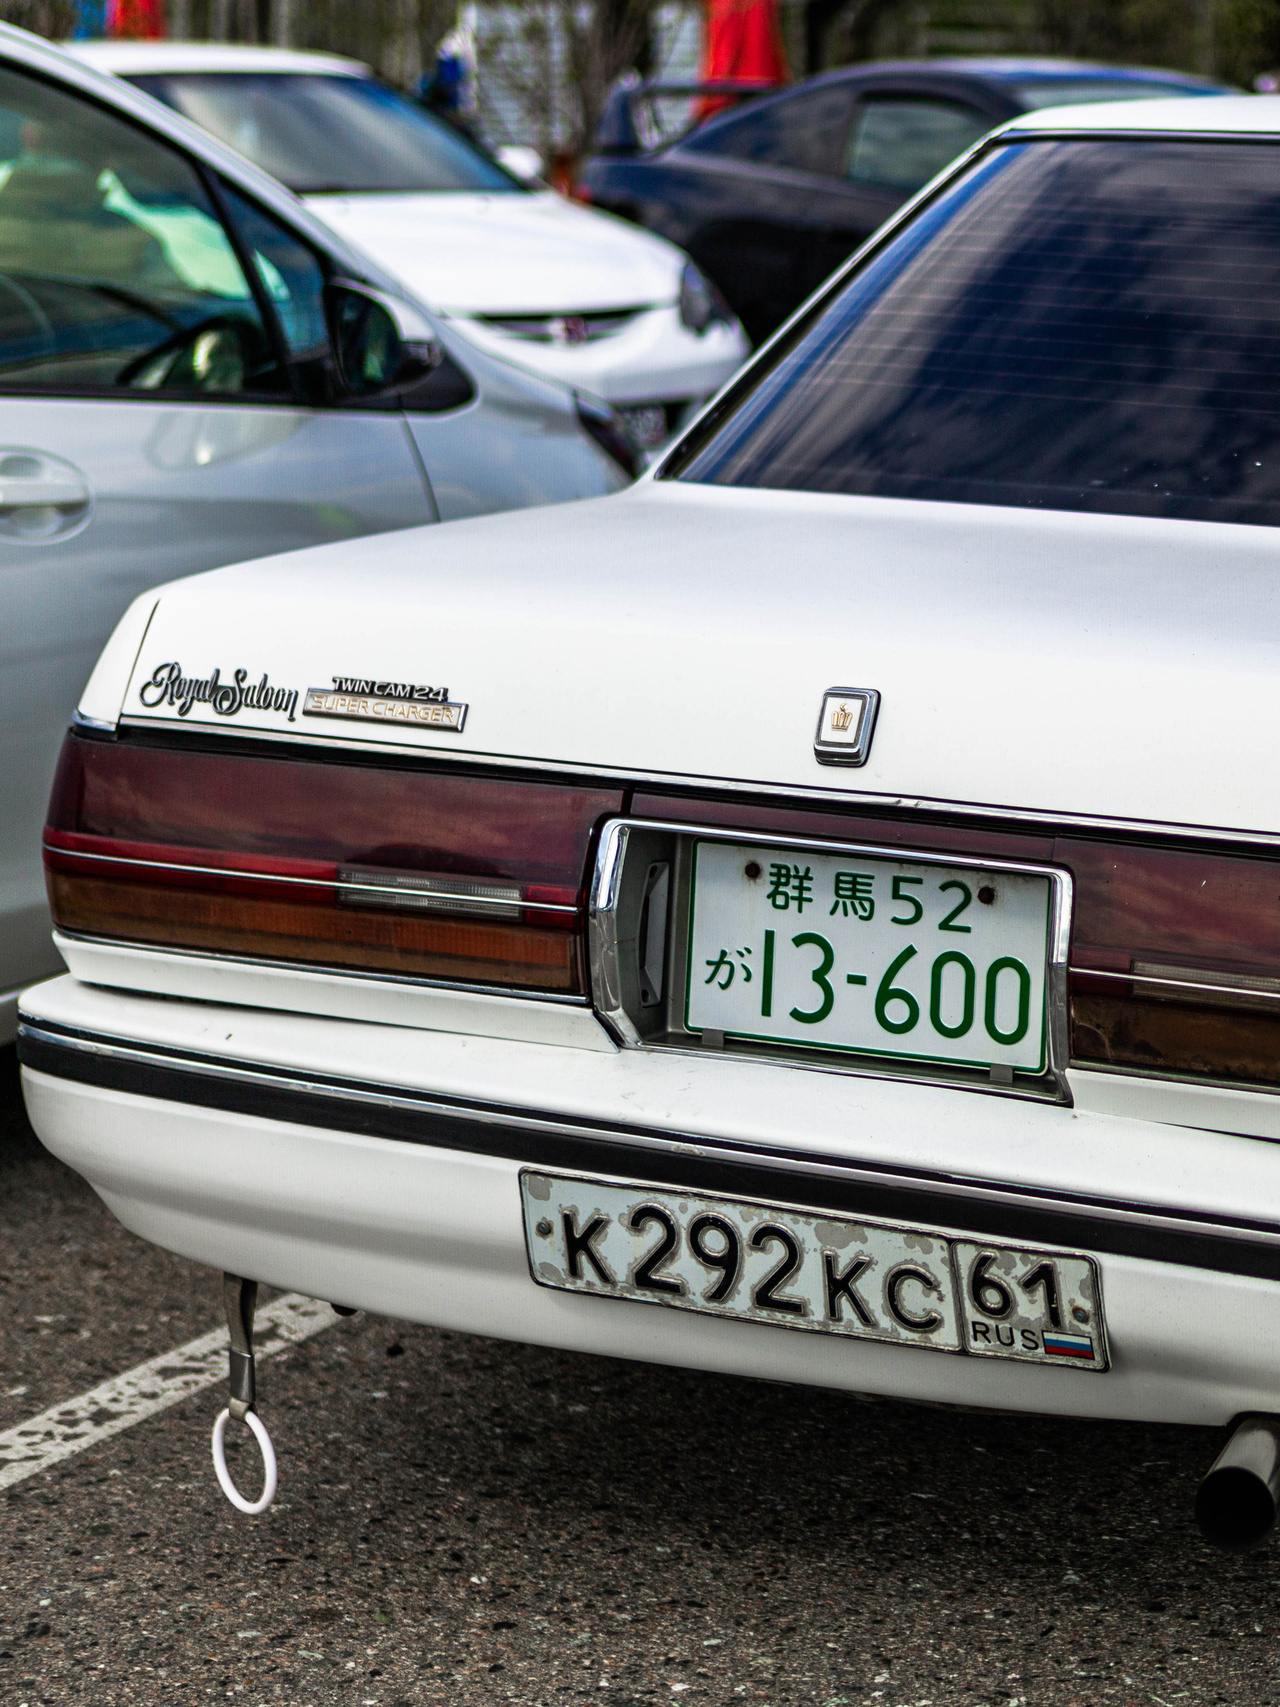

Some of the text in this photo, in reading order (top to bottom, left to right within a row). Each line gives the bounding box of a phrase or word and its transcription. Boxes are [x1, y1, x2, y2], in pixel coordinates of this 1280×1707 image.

[139, 661, 299, 722] Royal Saloon
[332, 676, 448, 702] TWIN CAM 24
[311, 694, 455, 723] SUPER CHARGER
[968, 1250, 1062, 1329] 61
[971, 1321, 1040, 1351] RUS
